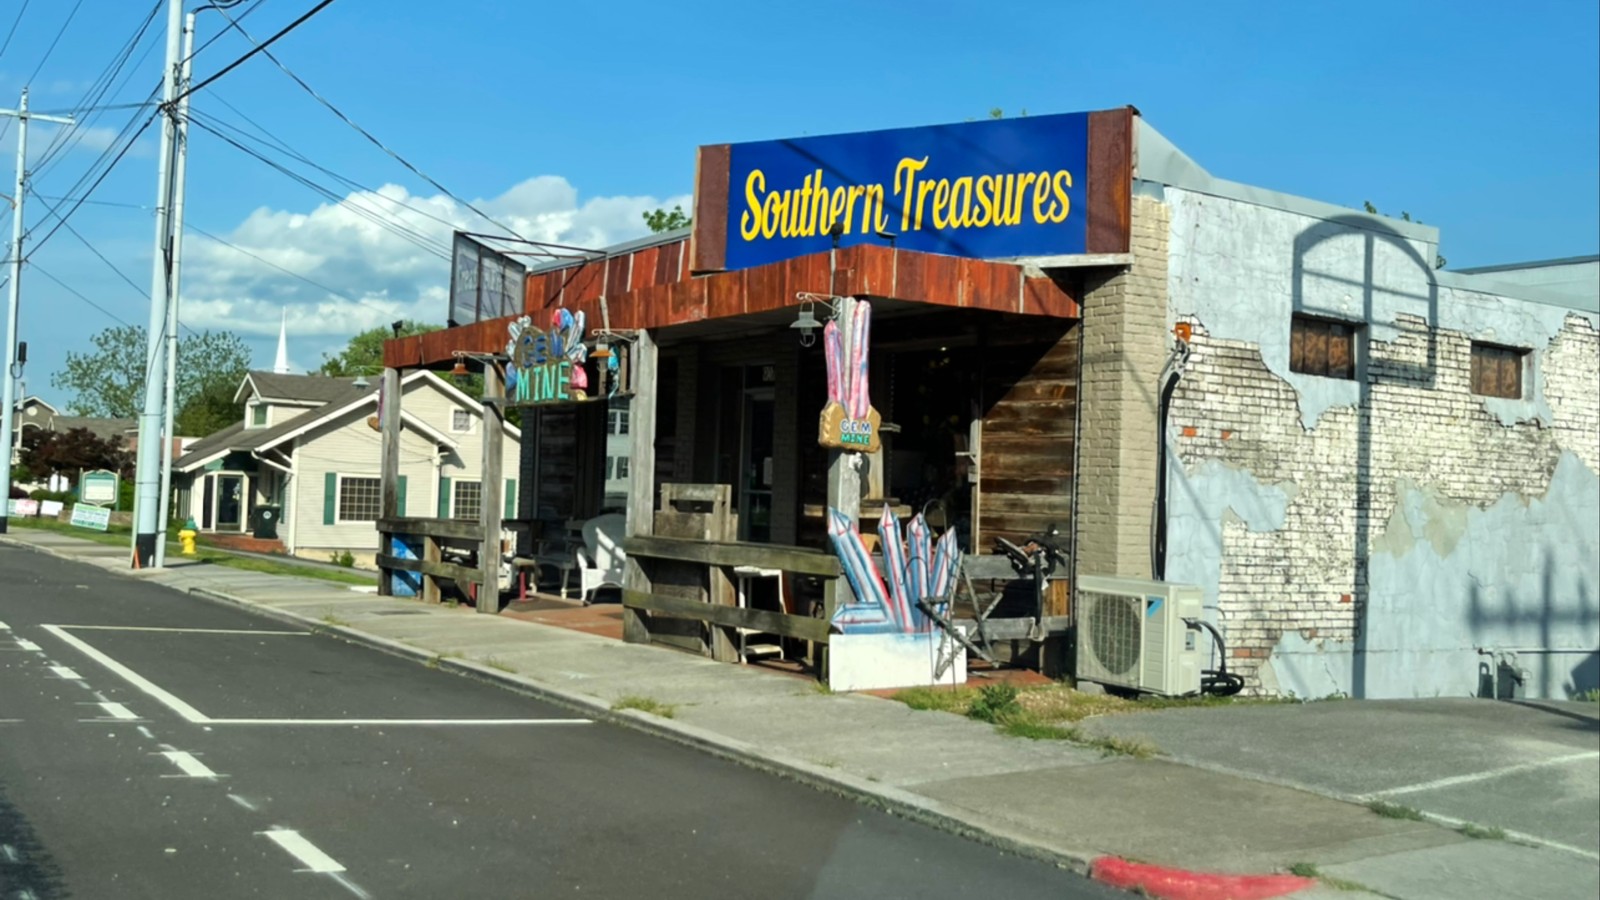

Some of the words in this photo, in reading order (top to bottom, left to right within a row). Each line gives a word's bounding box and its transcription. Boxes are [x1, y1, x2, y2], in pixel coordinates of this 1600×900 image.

[740, 168, 889, 241] Southern
[894, 156, 1072, 232] Treasures
[521, 328, 567, 369] GEM
[516, 361, 571, 402] MINE
[841, 420, 871, 433] GEM
[841, 433, 870, 445] MINE
